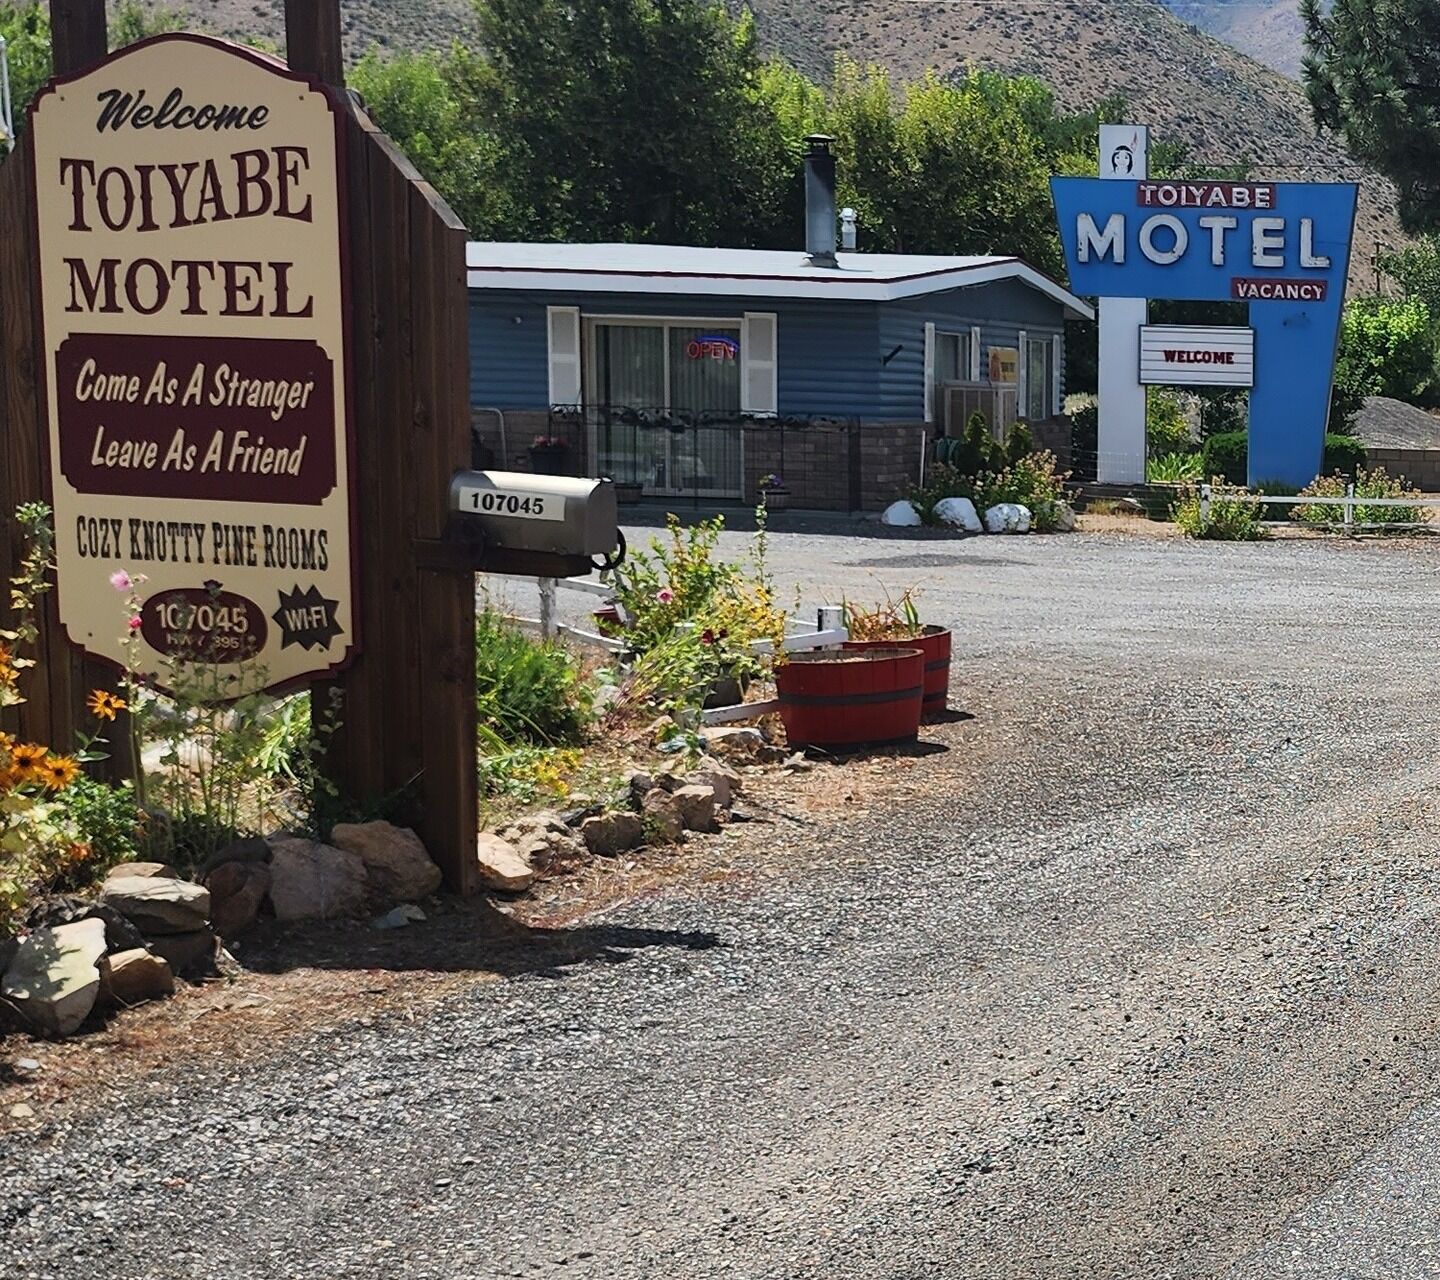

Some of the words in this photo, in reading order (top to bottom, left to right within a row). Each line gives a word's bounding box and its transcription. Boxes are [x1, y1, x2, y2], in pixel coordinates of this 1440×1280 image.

[96, 87, 271, 133] Welcome
[59, 145, 313, 232] TOIYABE
[1139, 184, 1271, 208] TOIYABE
[1077, 213, 1330, 268] MOTEL
[62, 257, 313, 318] MOTEL
[1236, 281, 1325, 300] VACANCY
[687, 341, 736, 360] OPEN
[1163, 349, 1235, 365] WELCOME
[75, 358, 140, 403] Come
[144, 361, 179, 405] As
[182, 362, 205, 407] A
[209, 363, 314, 422] Stranger
[91, 425, 158, 469] Leave
[162, 428, 198, 472] As
[201, 429, 224, 474] A
[227, 430, 308, 476] Friend
[471, 492, 544, 515] 107045
[76, 515, 123, 559] COZY
[128, 518, 206, 564] KNOTTY
[211, 522, 258, 567] PINE
[262, 524, 329, 571] ROOMS
[284, 606, 328, 633] WI-FI
[213, 636, 240, 649] 395
